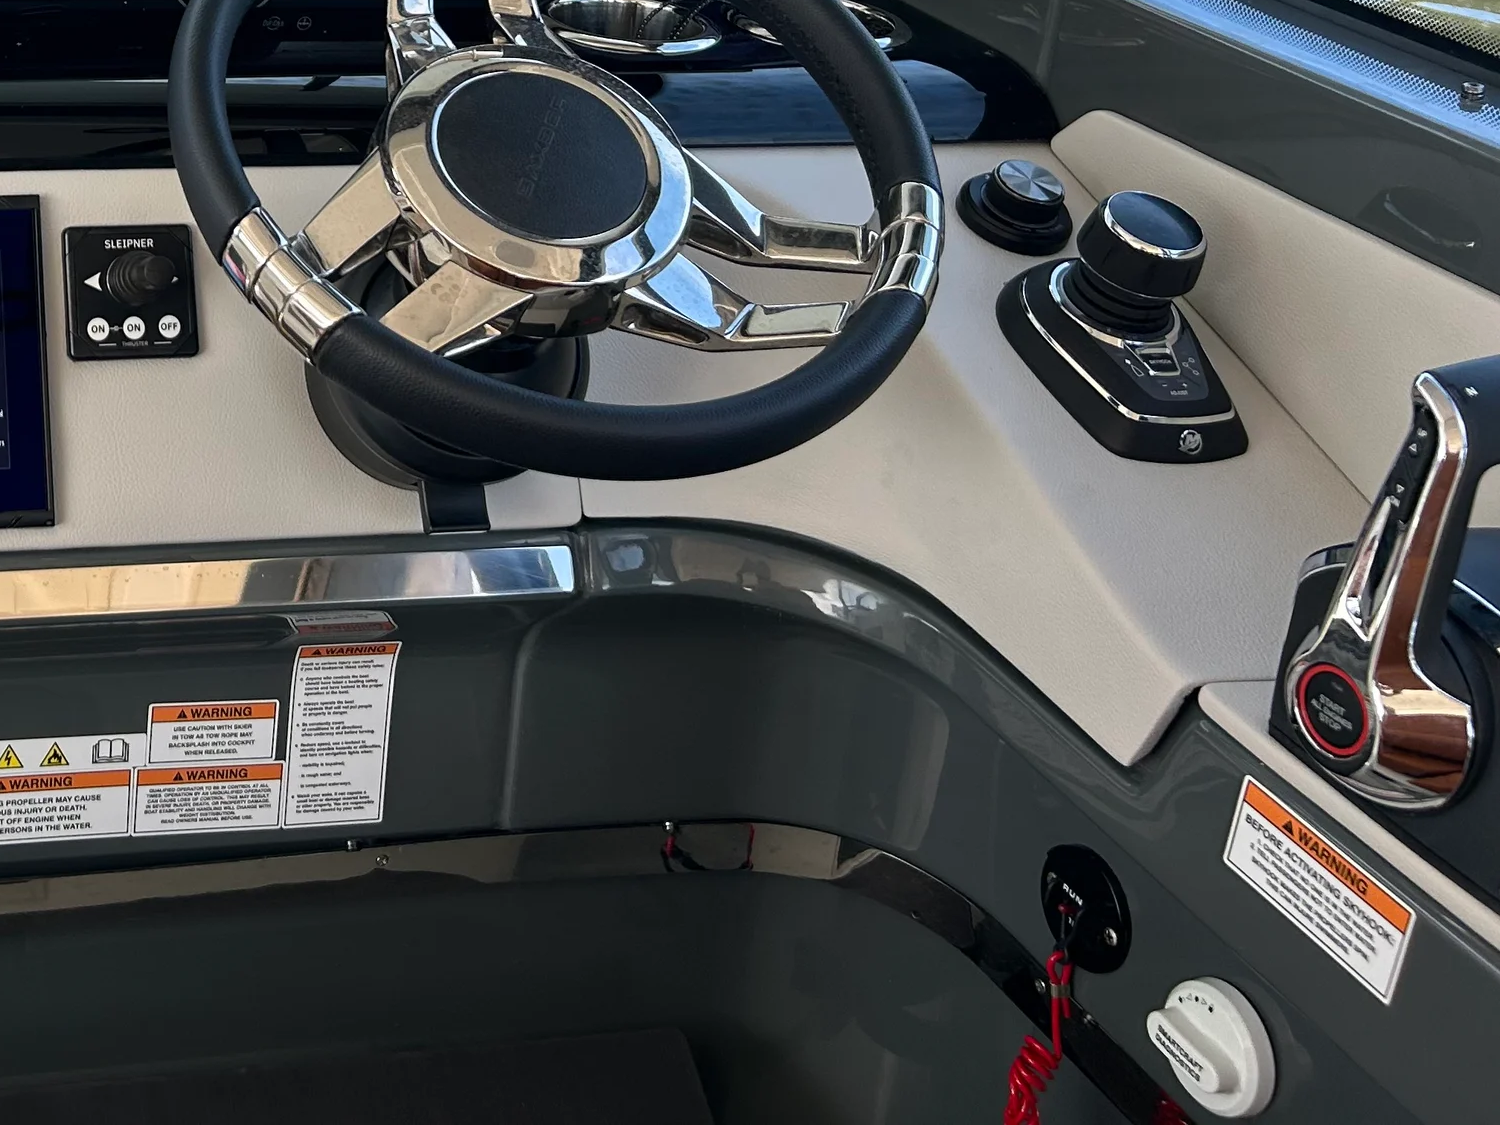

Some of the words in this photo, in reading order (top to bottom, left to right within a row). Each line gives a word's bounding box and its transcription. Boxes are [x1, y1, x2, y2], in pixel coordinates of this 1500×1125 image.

[105, 239, 153, 249] SLEIPNER
[91, 325, 105, 333] ON
[127, 324, 141, 332] ON
[161, 323, 177, 331] OFF
[325, 646, 386, 655] WARNING
[191, 707, 252, 718] WARNING
[186, 768, 248, 780] WARNING
[9, 776, 73, 790] WARNING
[6, 798, 53, 807] PROPELLER
[56, 796, 72, 804] MAY
[74, 794, 102, 802] CAUSE
[14, 807, 43, 815] INJURY
[59, 804, 87, 812] DEATH.
[63, 822, 92, 830] WATER.
[1245, 813, 1283, 850] BEFORE
[1284, 847, 1342, 899] ACTIVATING
[1298, 827, 1368, 896] WARNING
[1063, 883, 1083, 906] RUN
[1158, 1024, 1203, 1071] SMARTCRAFT
[1156, 1033, 1200, 1081] DIAGNOSTICS
